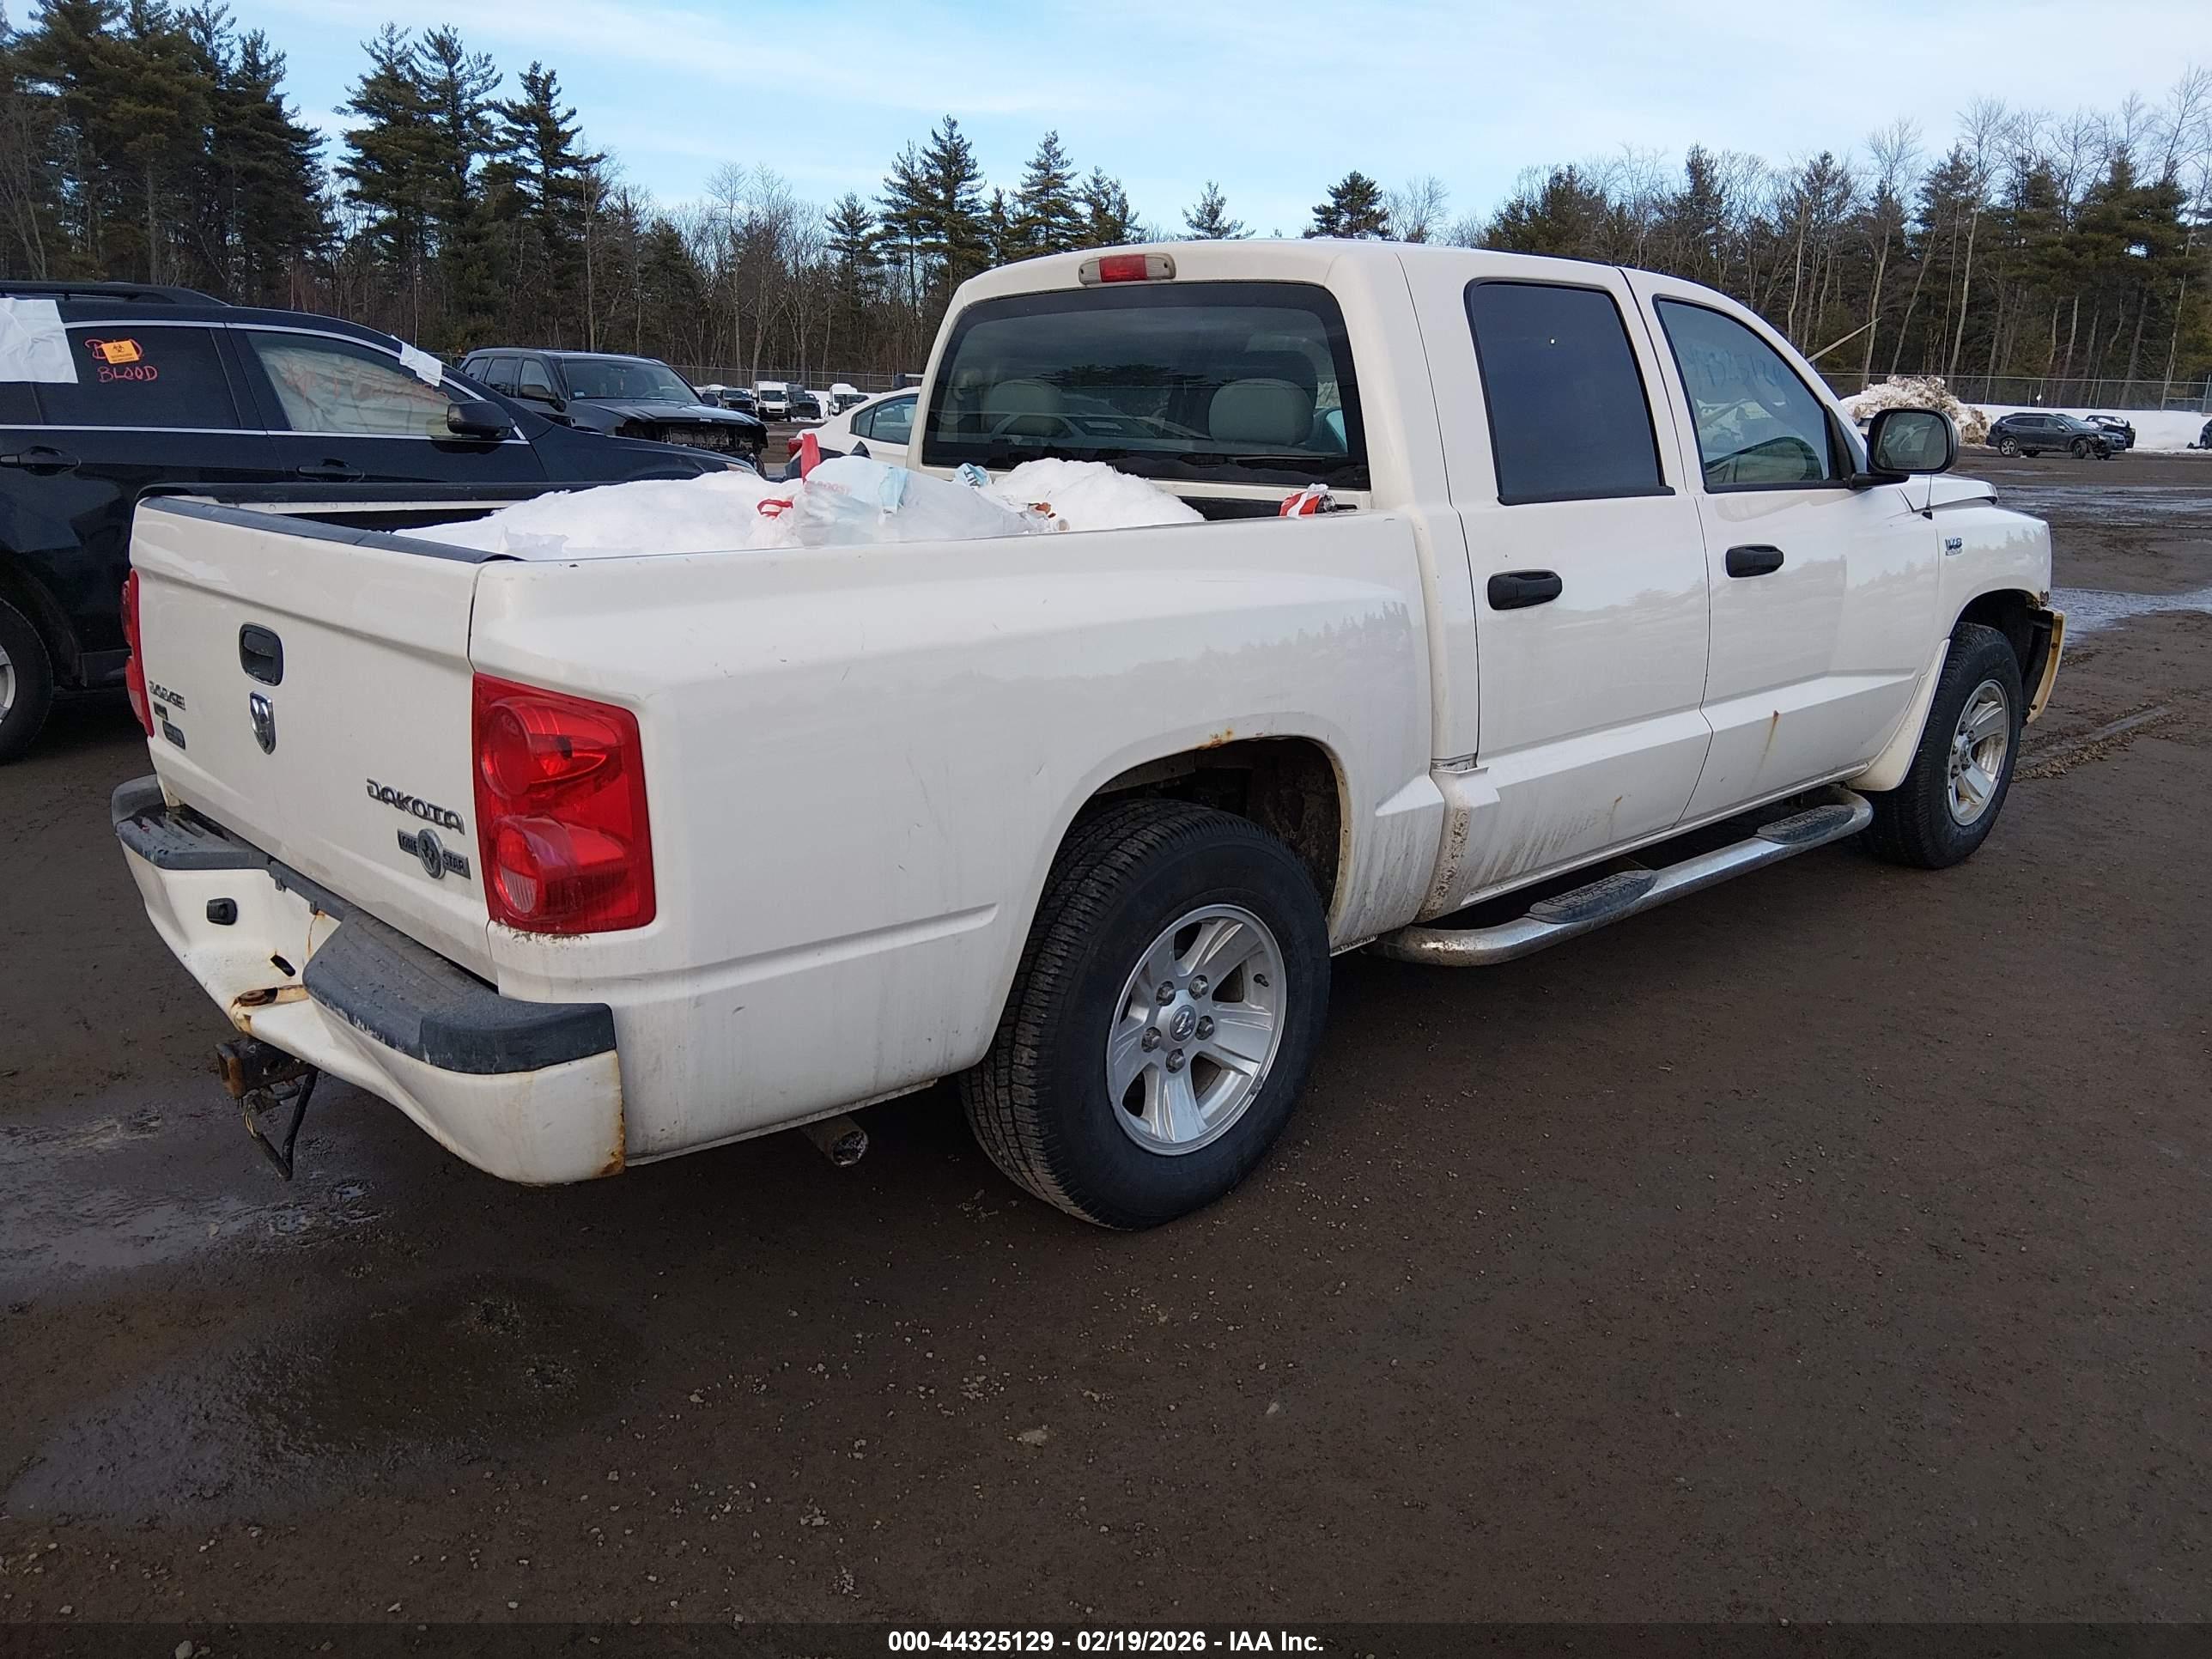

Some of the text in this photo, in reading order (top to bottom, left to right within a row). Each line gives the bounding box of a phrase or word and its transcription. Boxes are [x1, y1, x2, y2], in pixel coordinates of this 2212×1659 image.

[97, 365, 158, 383] BLOOD
[366, 778, 465, 836] DAKOTA
[442, 853, 465, 871] STAR
